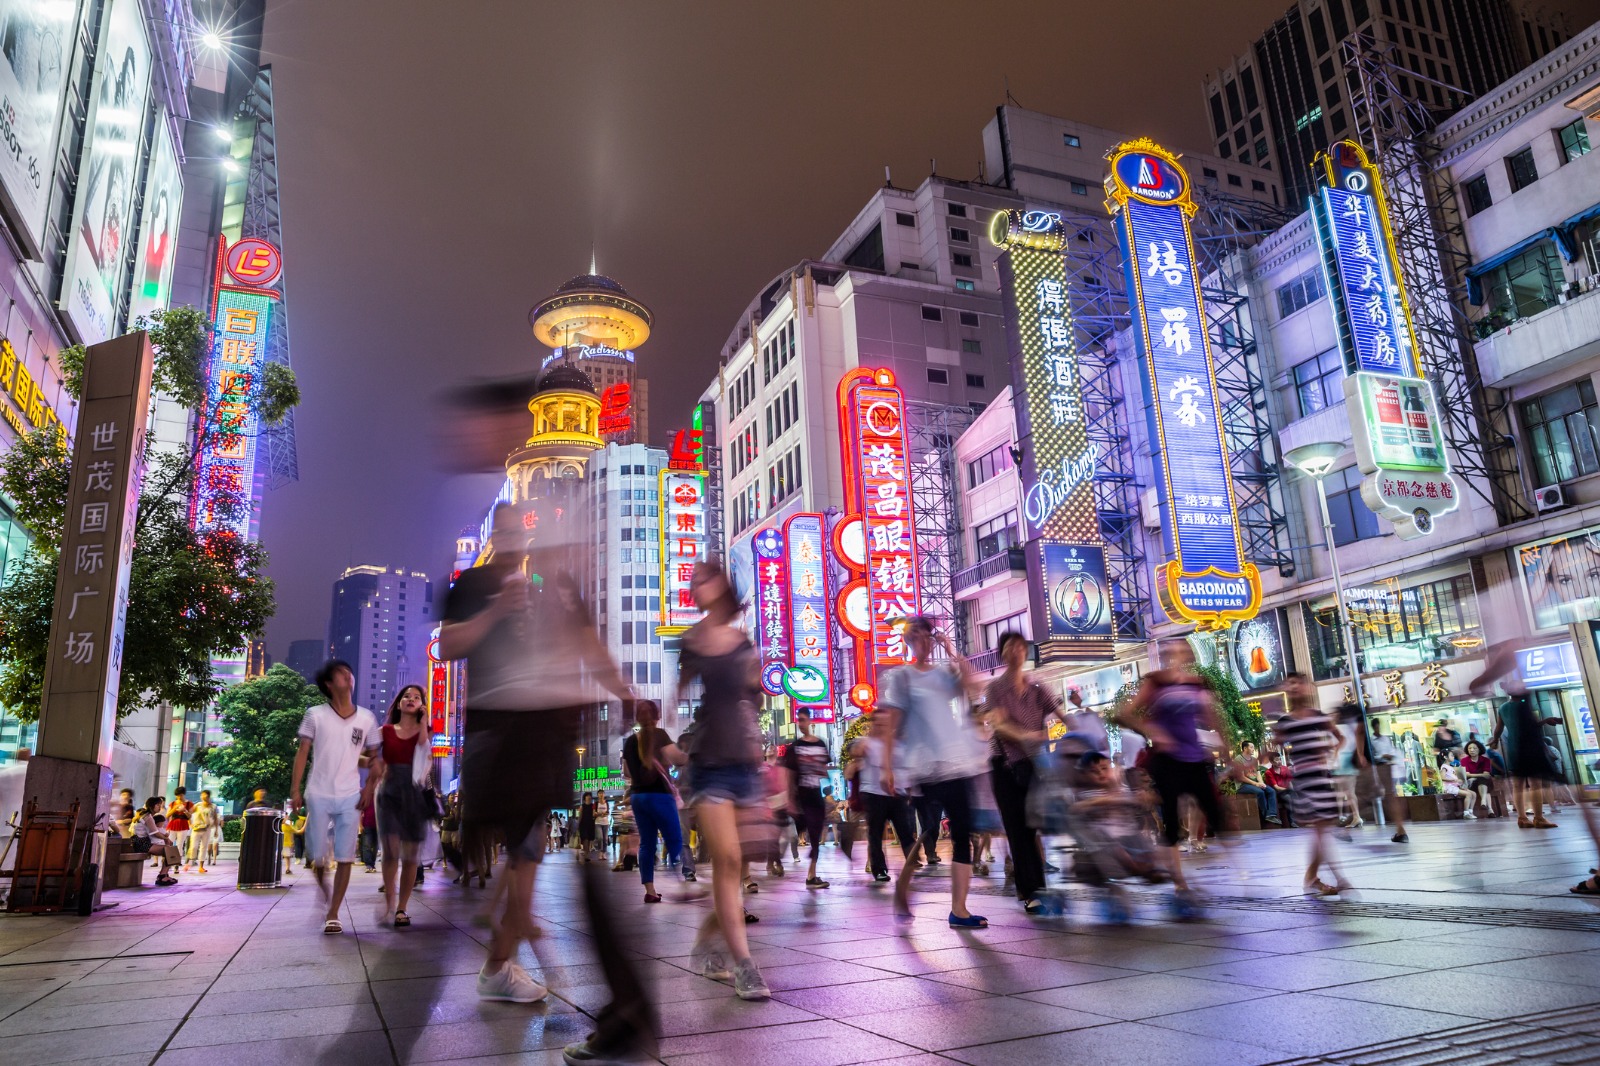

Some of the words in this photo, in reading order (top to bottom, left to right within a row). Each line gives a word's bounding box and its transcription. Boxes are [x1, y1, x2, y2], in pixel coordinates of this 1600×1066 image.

[1131, 186, 1172, 199] BAROMON
[1342, 194, 1397, 365] 华美大药房
[579, 342, 625, 360] Radisson
[1025, 442, 1100, 530] Duchamp
[1382, 479, 1453, 499] 京都念慈菴
[1184, 495, 1224, 507] 培罗蒙
[1181, 513, 1232, 525] 西服公司
[64, 422, 119, 664] 世茂国际广场
[867, 444, 915, 662] 茂昌眼镜公司
[795, 534, 824, 659] 泰康食品
[1179, 582, 1247, 596] BAROMON
[573, 766, 621, 781] 海市第一
